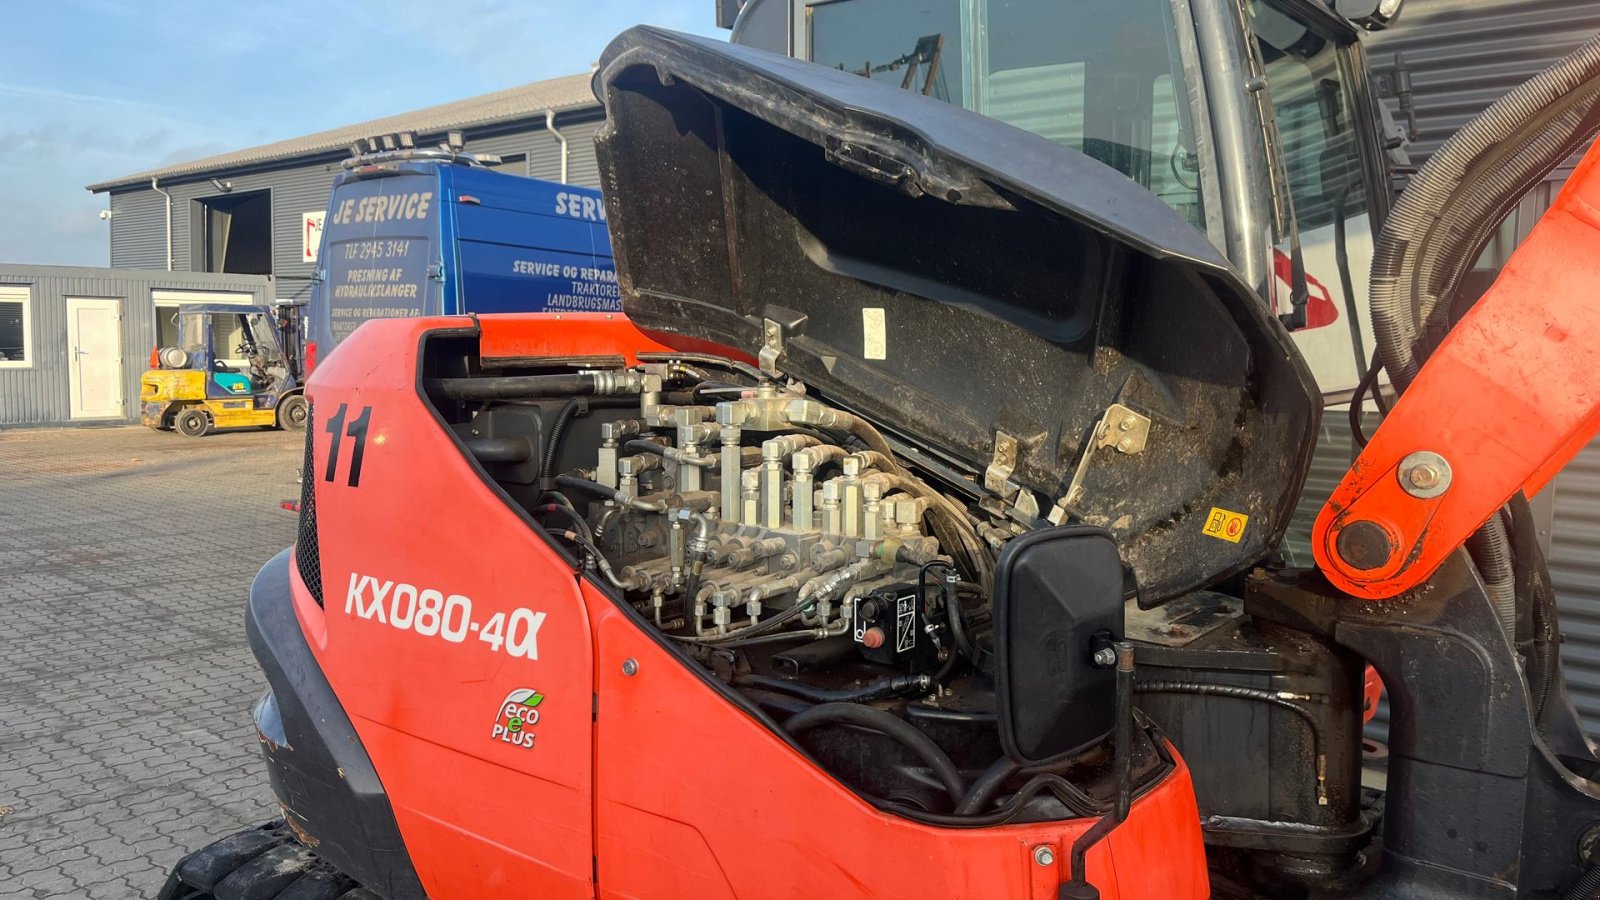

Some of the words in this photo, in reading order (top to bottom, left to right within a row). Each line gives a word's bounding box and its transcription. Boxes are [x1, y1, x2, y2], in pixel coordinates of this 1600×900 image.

[333, 199, 355, 225] JE
[355, 192, 433, 223] SERVICE
[345, 243, 359, 260] TLF
[359, 242, 385, 260] 2945
[385, 240, 410, 257] 3141
[347, 268, 389, 283] PRESNING
[389, 268, 403, 281] AF
[512, 259, 560, 277] SERVICE
[562, 264, 579, 279] OG
[335, 283, 418, 299] HYDRAULIKSLANGER
[325, 402, 373, 488] 11
[504, 703, 540, 725] eco
[491, 723, 535, 748] PLUS
